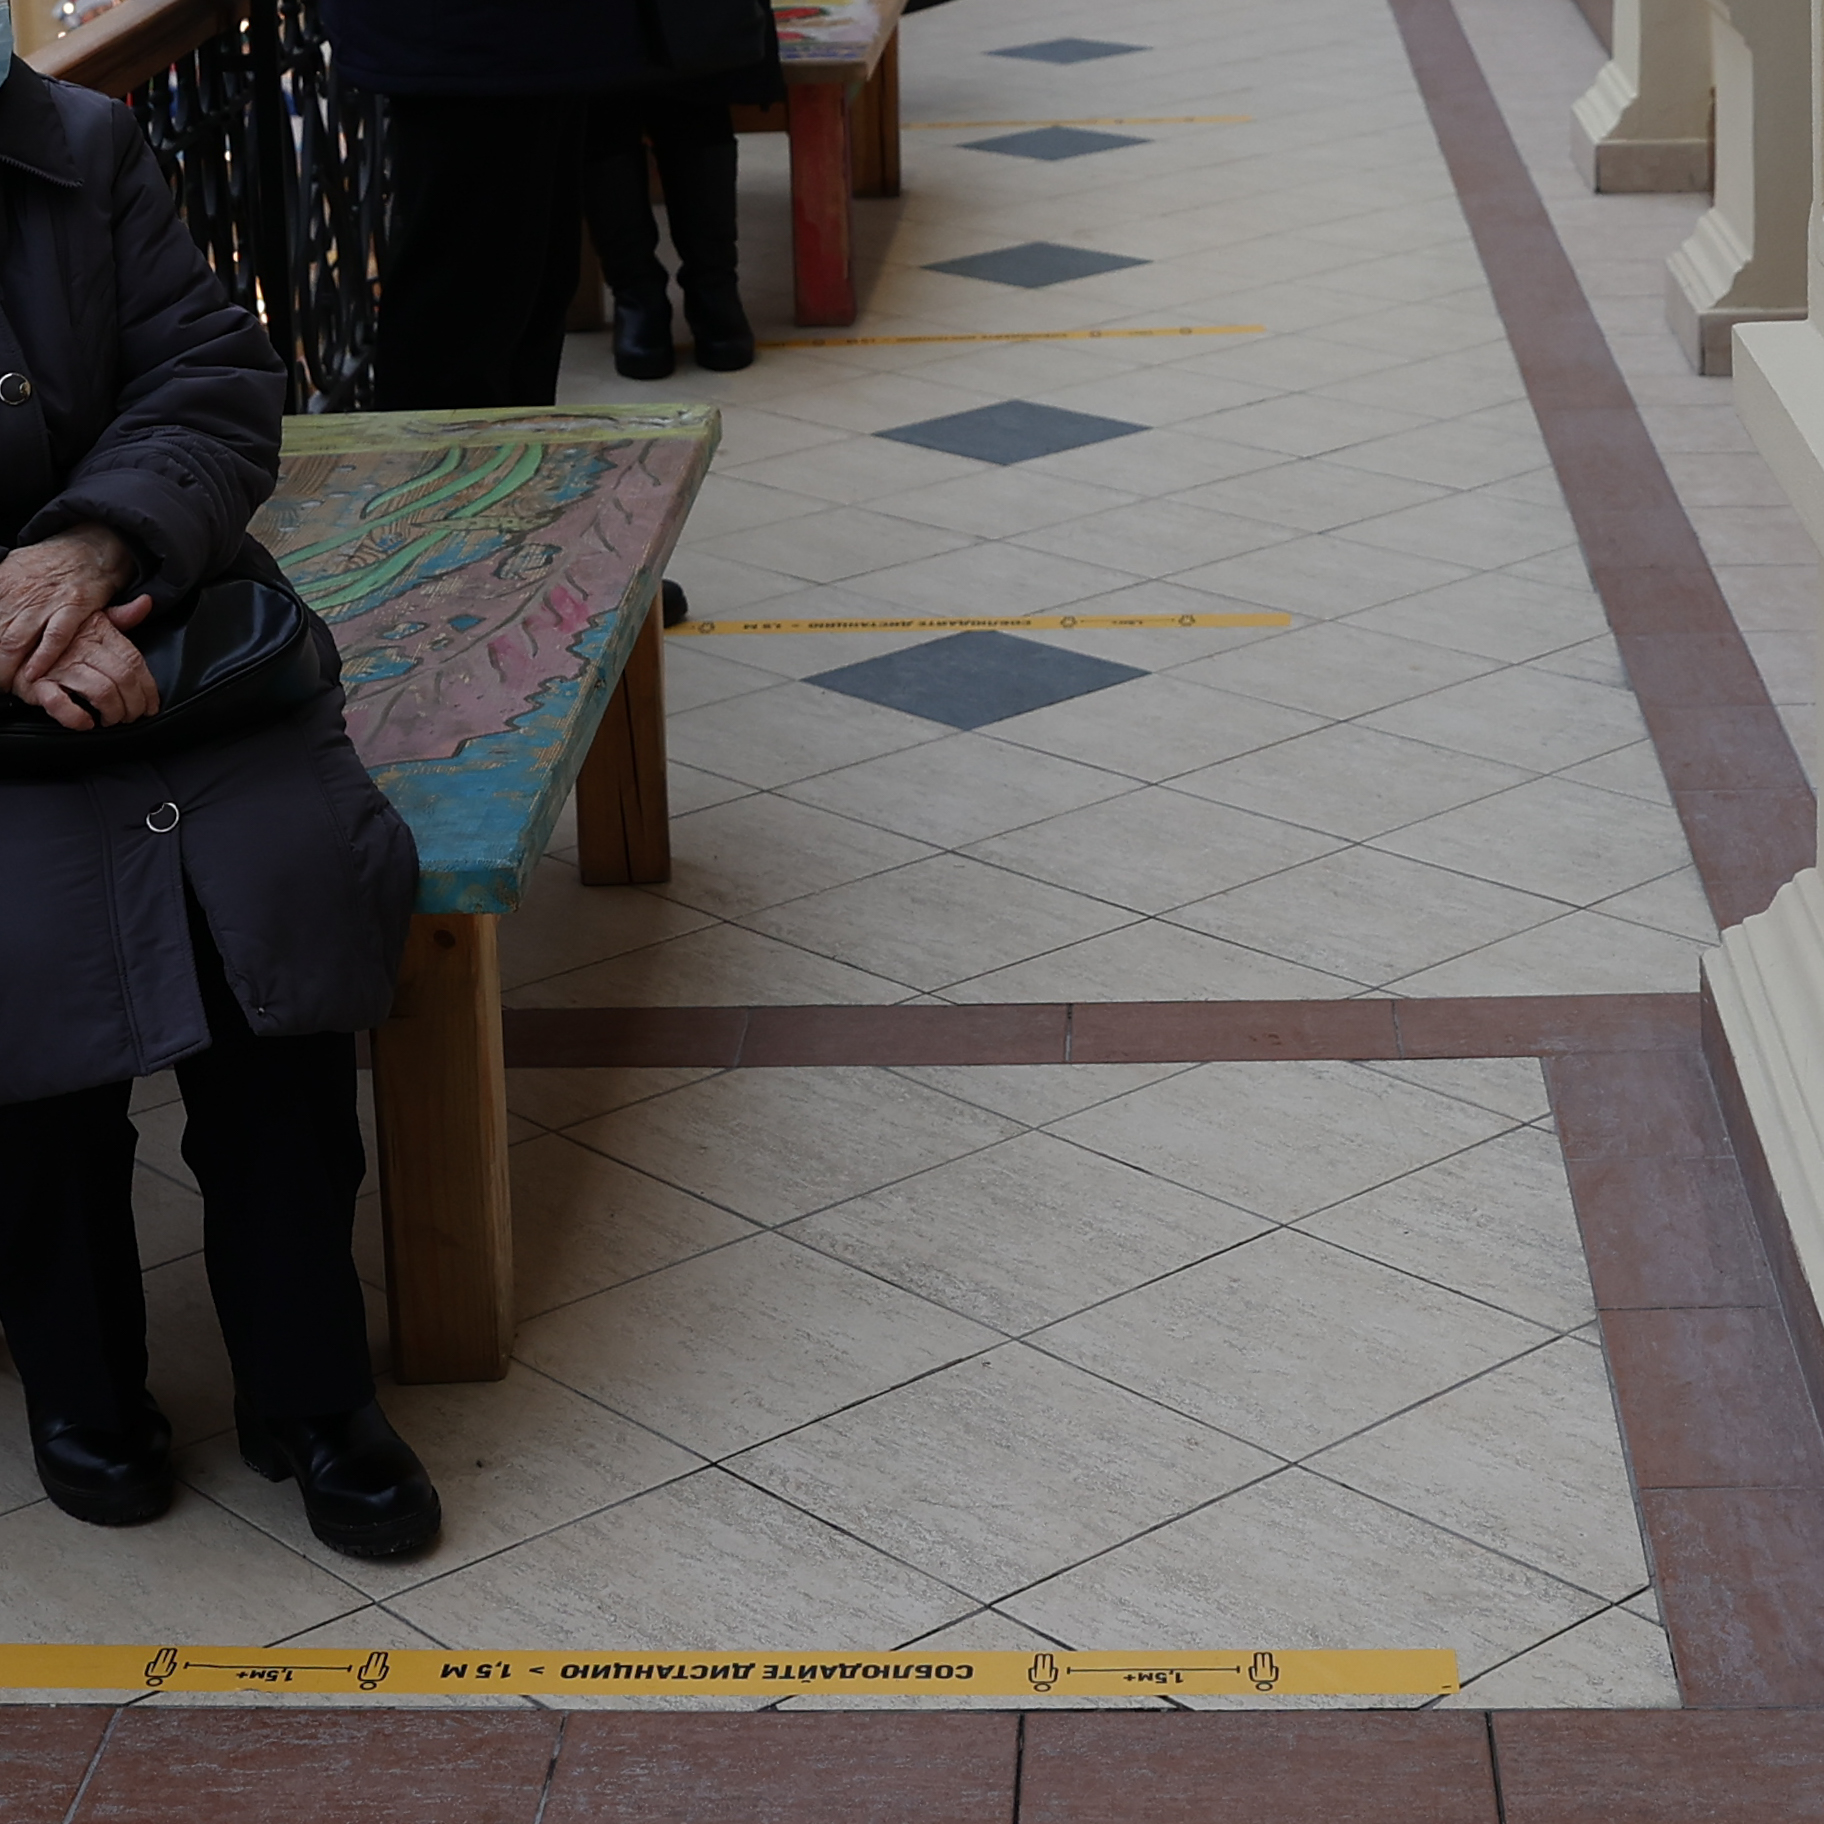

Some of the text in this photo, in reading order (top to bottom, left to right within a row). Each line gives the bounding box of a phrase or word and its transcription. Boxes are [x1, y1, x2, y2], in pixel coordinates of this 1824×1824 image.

[440, 1663, 468, 1678] М
[476, 1660, 512, 1679] 1,5
[559, 1661, 756, 1679] ДИСТАНЦИЮ
[762, 1661, 974, 1683] СОБЛЮДАЙТЕ
